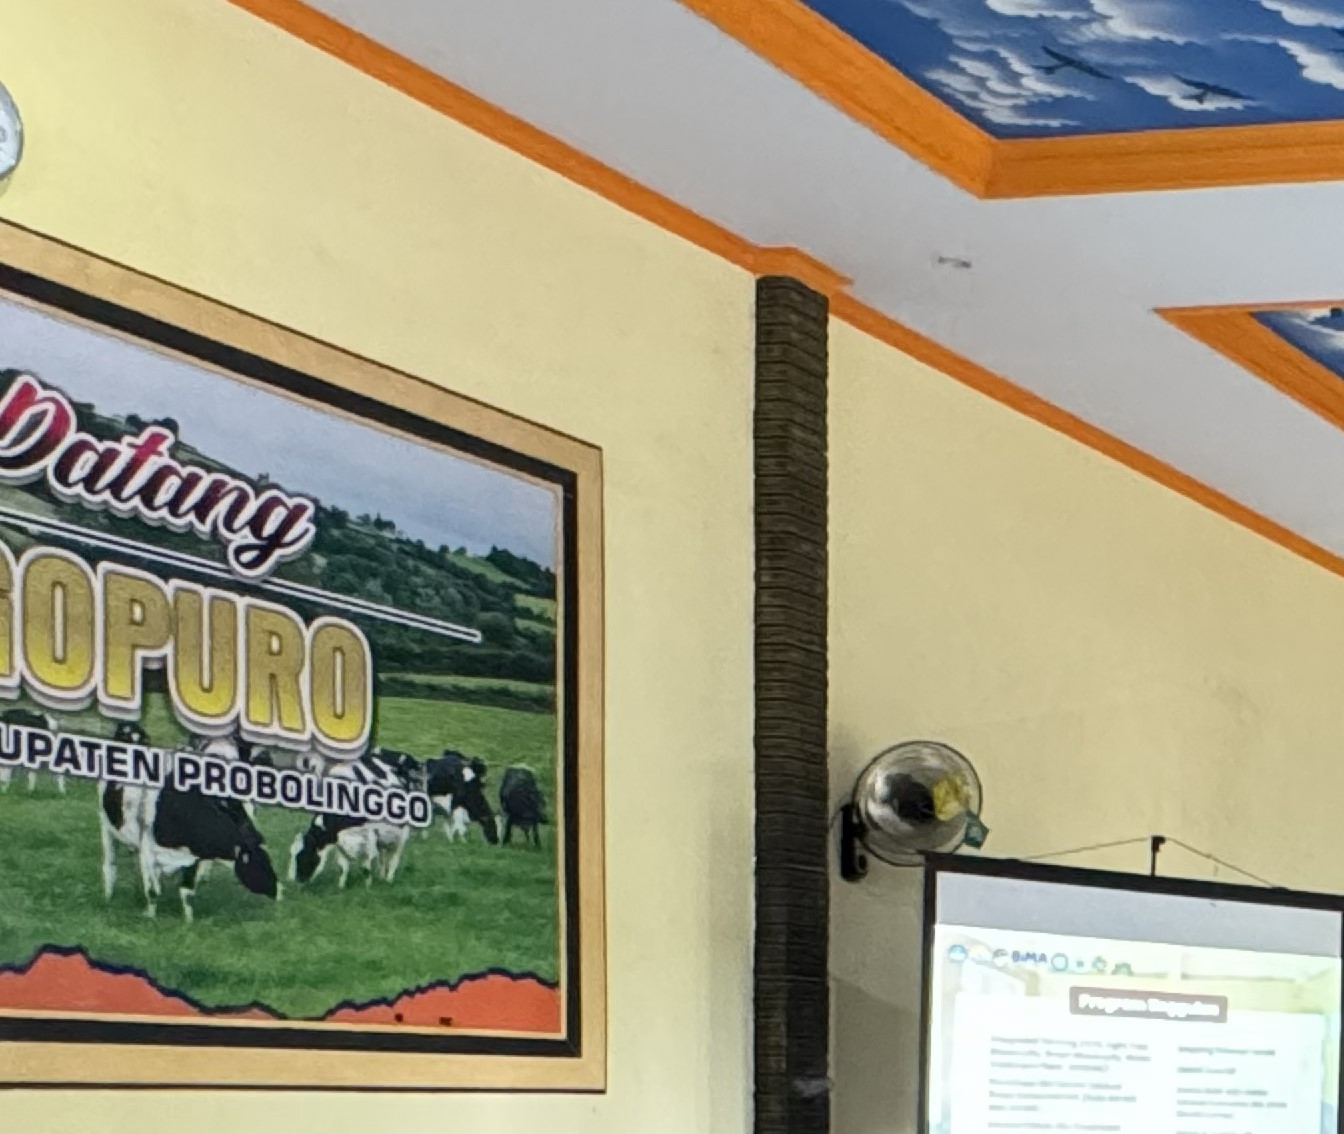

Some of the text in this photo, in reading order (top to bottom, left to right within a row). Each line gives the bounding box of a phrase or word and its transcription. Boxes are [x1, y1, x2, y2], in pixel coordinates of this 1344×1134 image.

[0, 375, 314, 573] Datang
[0, 545, 372, 745] OPURO
[176, 756, 430, 824] PROBOLINGGO
